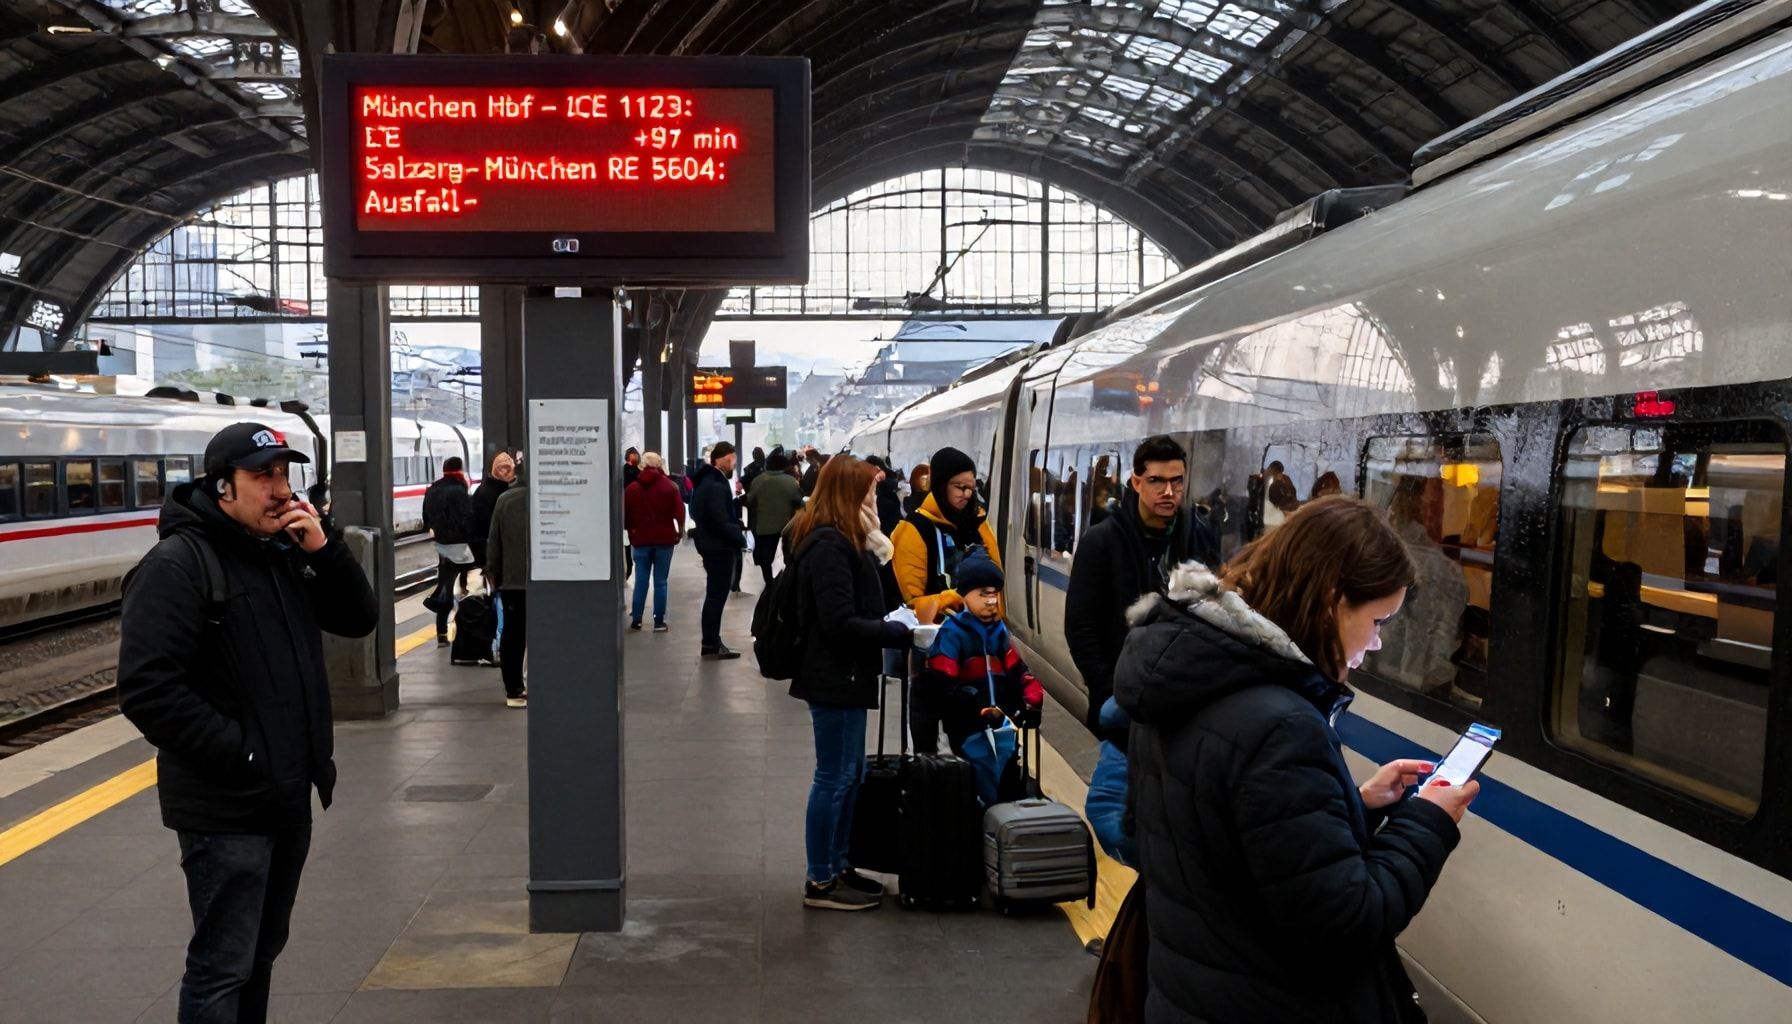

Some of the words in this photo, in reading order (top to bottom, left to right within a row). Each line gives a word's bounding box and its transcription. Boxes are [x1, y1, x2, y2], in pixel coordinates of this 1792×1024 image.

[362, 93, 477, 118] München
[618, 94, 692, 119] 1123:
[634, 126, 682, 149] +97
[692, 127, 737, 149] min
[607, 156, 640, 180] RE
[651, 156, 725, 180] 5604:
